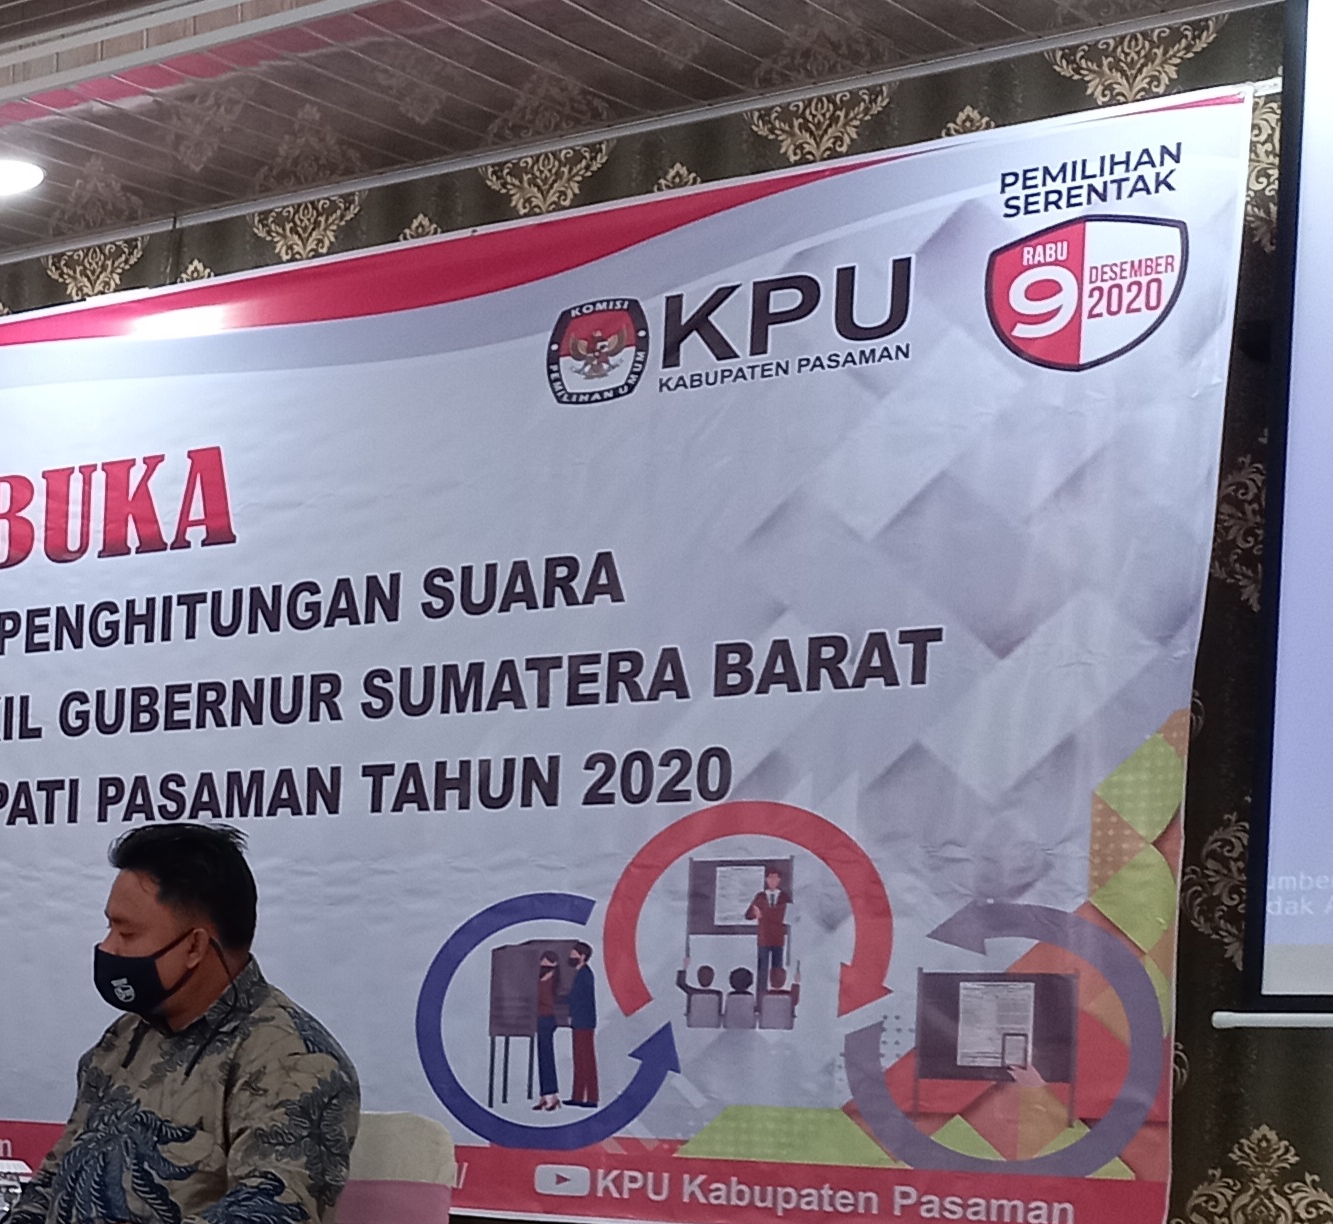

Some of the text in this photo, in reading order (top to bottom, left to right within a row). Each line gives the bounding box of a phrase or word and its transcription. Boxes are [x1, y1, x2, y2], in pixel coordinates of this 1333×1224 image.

[999, 141, 1183, 194] PEMILIHAN
[1003, 170, 1178, 219] SERENTAK
[1022, 239, 1069, 267] RABU
[1088, 254, 1176, 287] DESEMBER
[570, 300, 629, 318] KOMISI
[662, 256, 915, 370] KPU
[1006, 265, 1080, 339] 9
[1086, 279, 1163, 320] 2020
[549, 351, 646, 402] PEMILIHAN UMUM
[658, 342, 912, 393] KABUPATEN PASAMAN
[421, 550, 626, 620] SUARA
[59, 673, 342, 737] GUBERNUR
[361, 646, 690, 719] SUMATERA
[713, 627, 943, 697] BARAT
[97, 765, 341, 823] PASAMAN
[362, 755, 560, 814] TAHUN
[582, 746, 732, 806] 2020
[595, 1168, 671, 1202] KPU
[682, 1174, 879, 1219] Kabupaten
